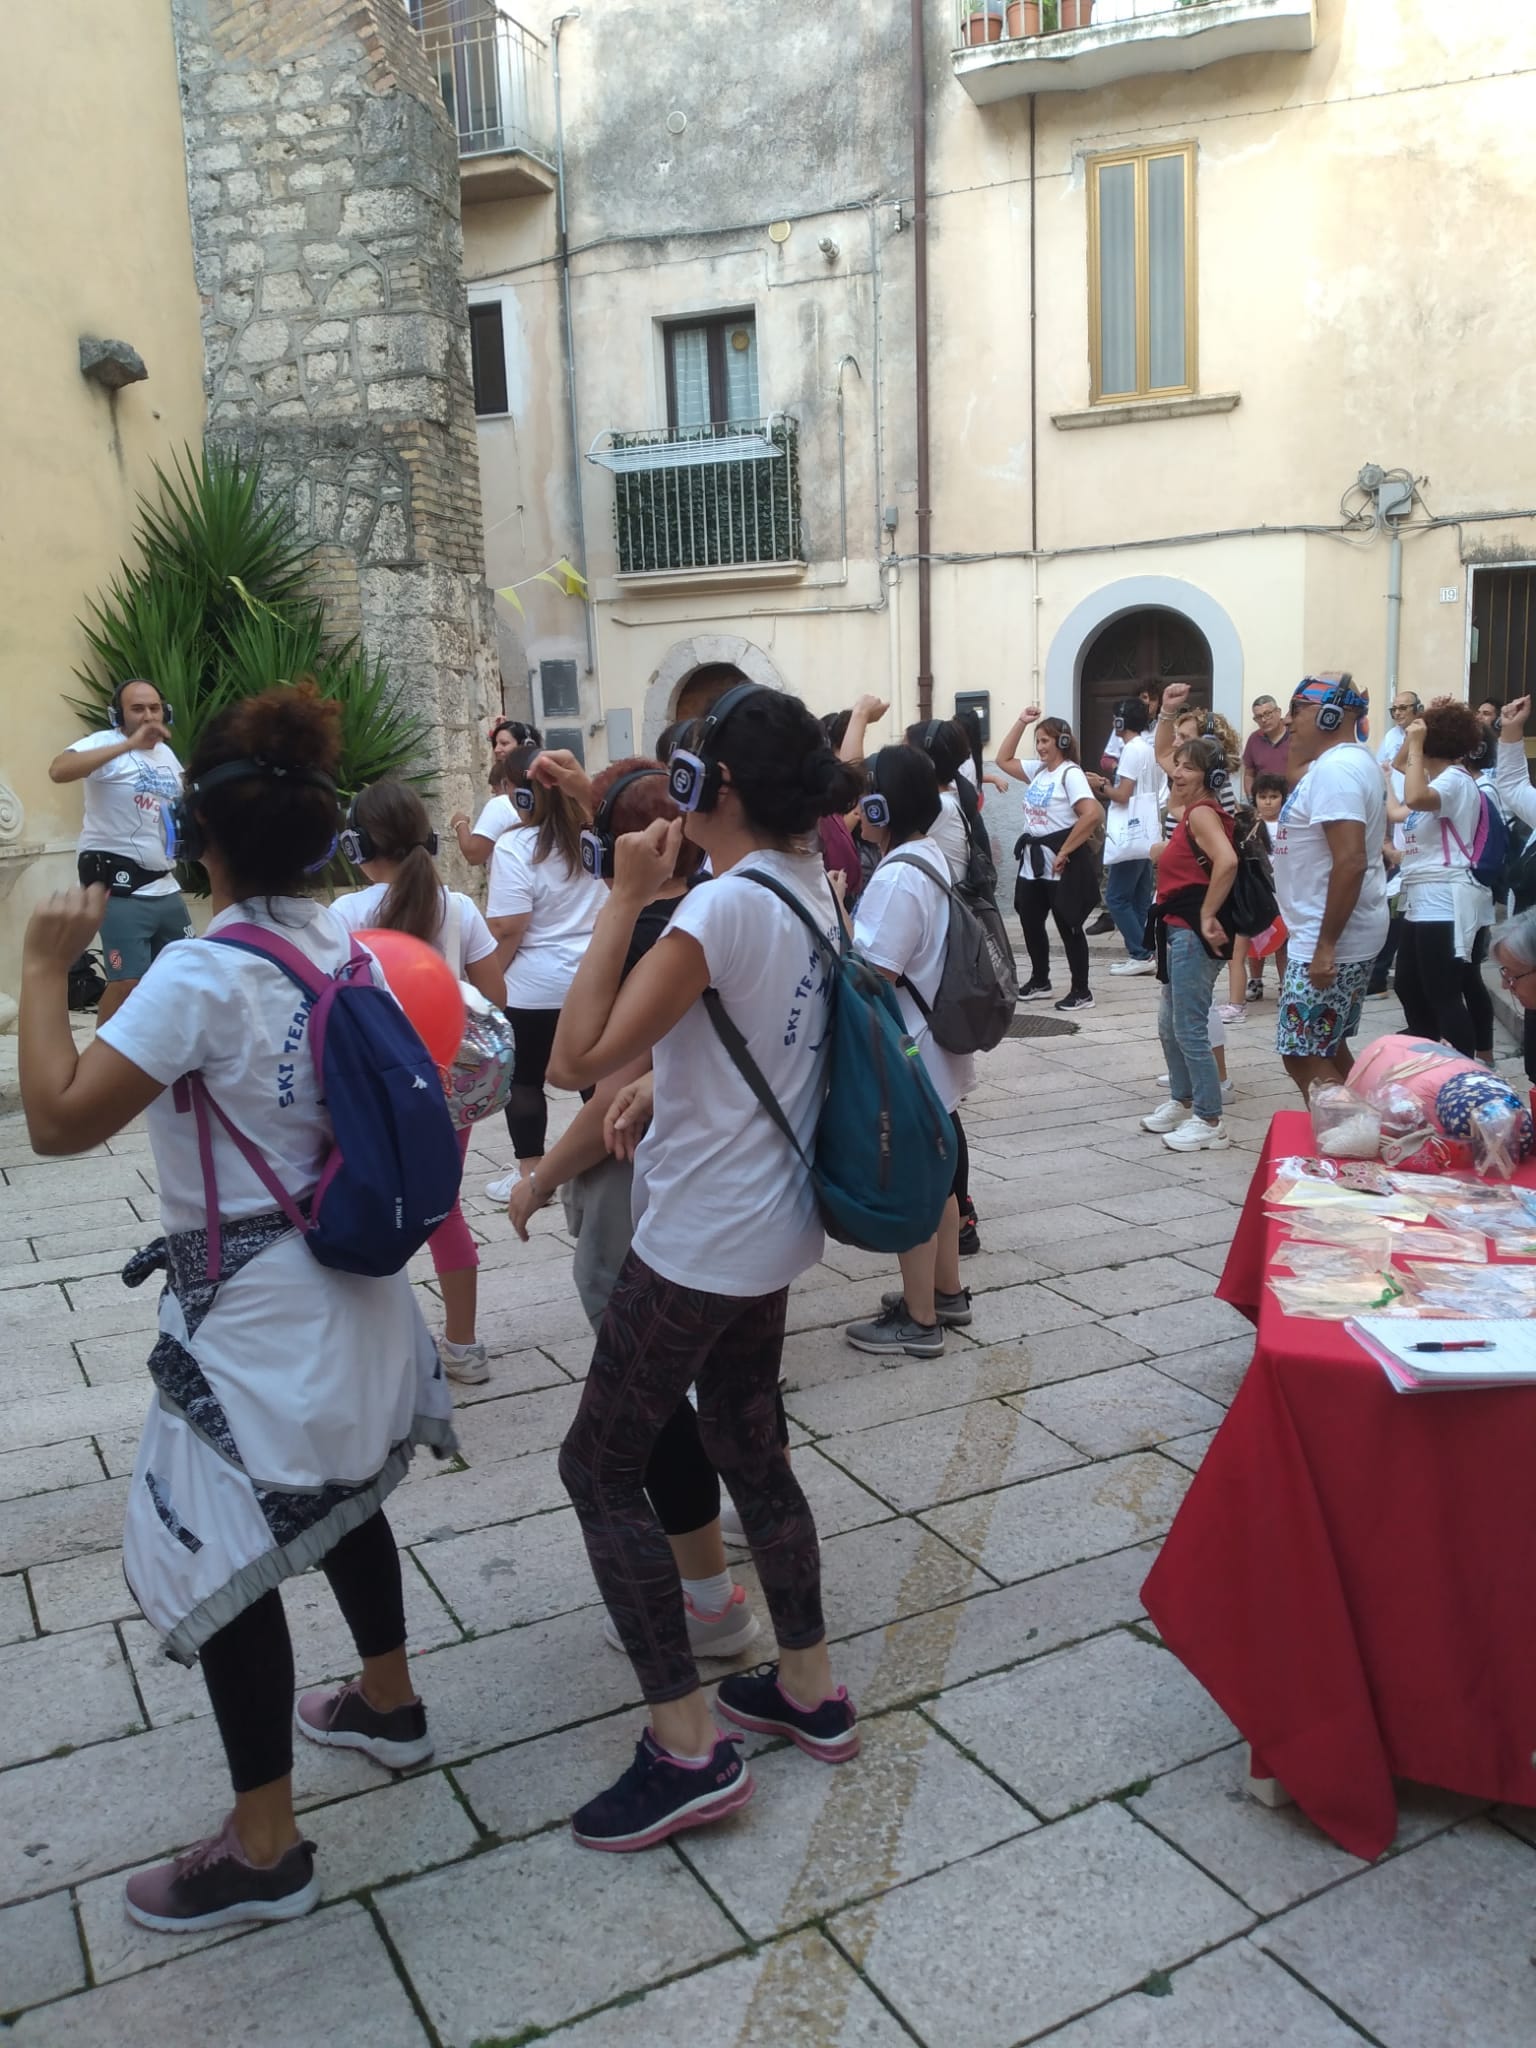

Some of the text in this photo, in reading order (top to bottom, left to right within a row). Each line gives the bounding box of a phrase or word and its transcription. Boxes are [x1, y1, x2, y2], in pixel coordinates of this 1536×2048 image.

[1444, 589, 1455, 601] 19
[784, 949, 820, 1046] SKI TEM
[277, 1063, 295, 1108] SKI
